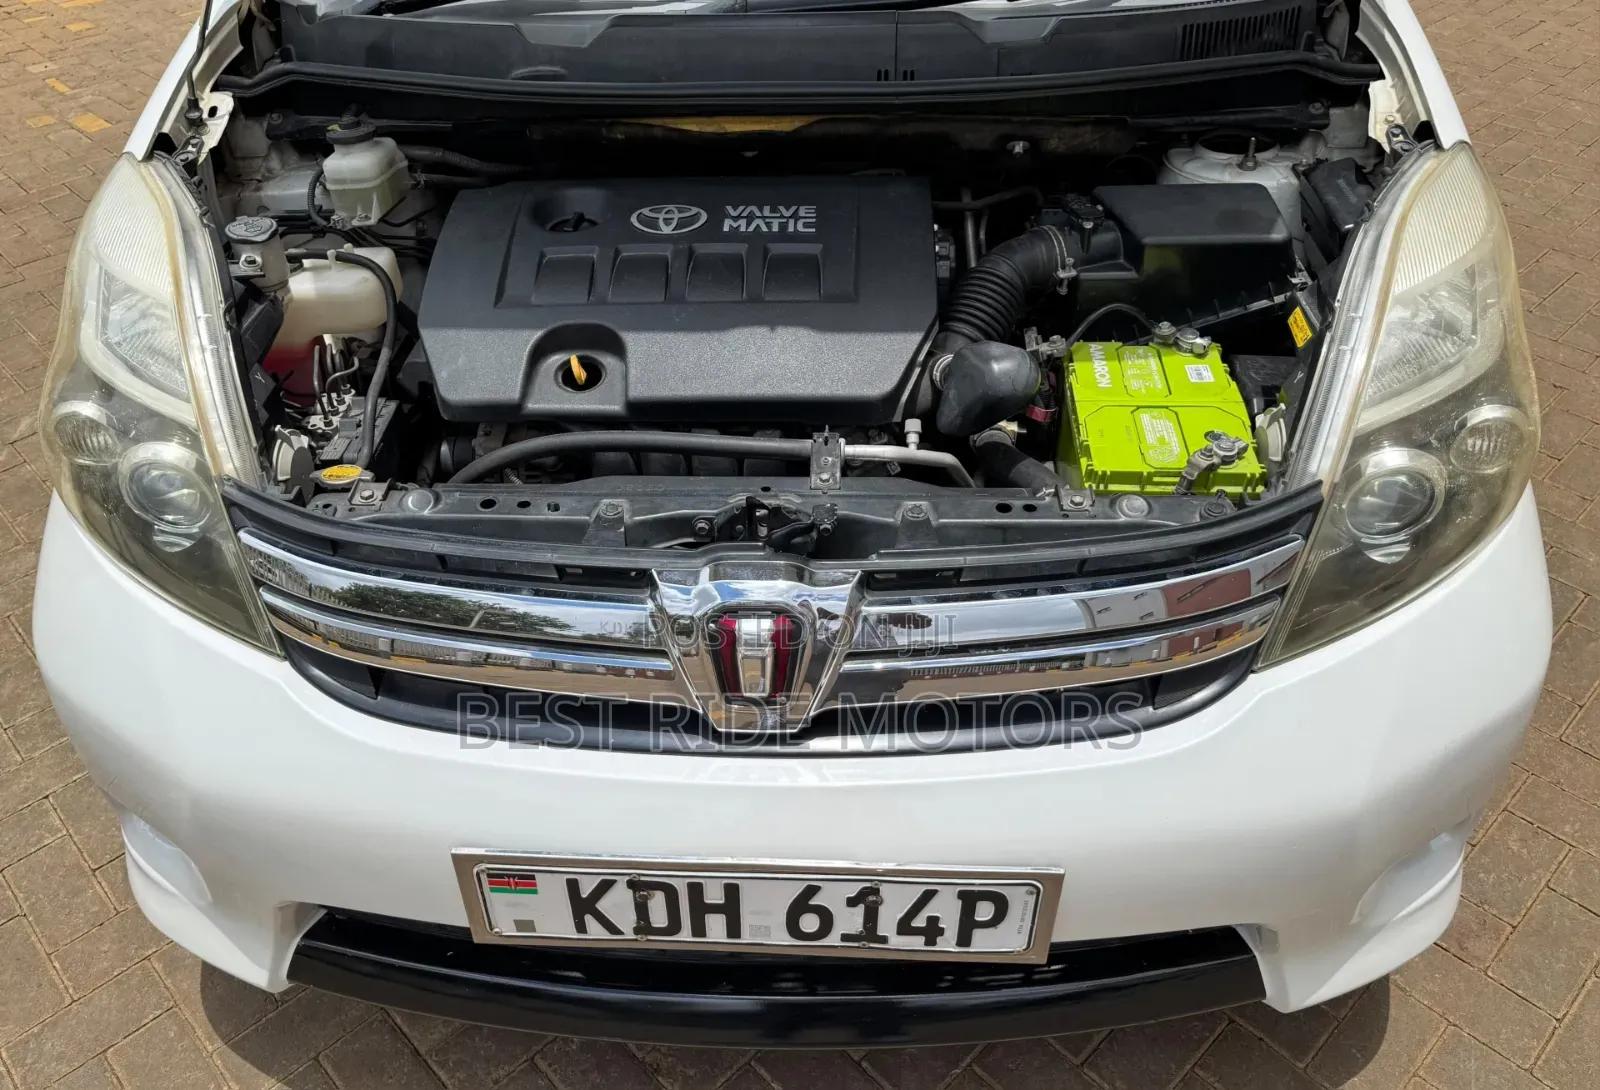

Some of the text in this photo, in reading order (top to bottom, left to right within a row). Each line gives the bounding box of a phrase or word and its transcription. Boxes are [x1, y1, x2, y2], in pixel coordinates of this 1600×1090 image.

[723, 218, 816, 232] MATIC
[725, 205, 817, 217] VALVE
[1089, 343, 1112, 388] AMARON
[565, 877, 1010, 948] KDH 614P
